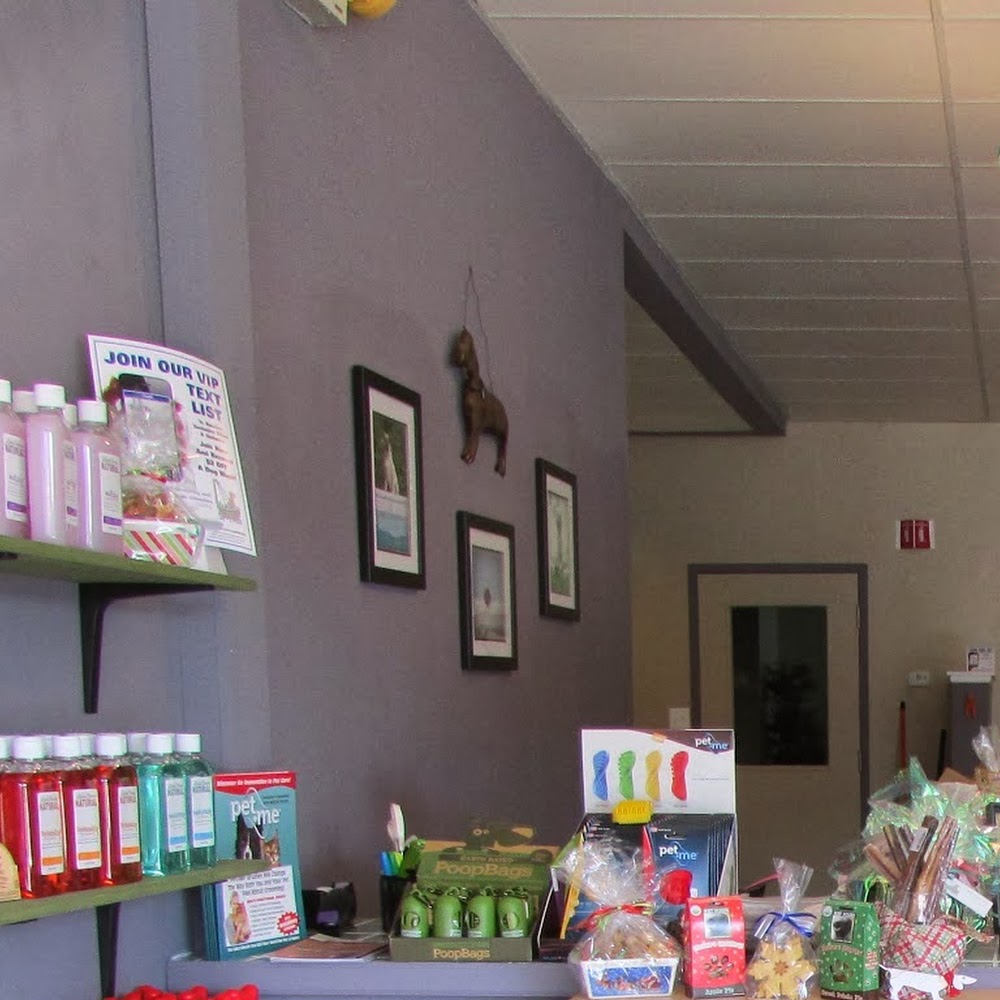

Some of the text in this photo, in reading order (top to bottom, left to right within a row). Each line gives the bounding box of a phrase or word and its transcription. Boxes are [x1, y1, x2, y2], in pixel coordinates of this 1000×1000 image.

[104, 352, 219, 389] JOIN OUR VIP
[186, 383, 221, 406] TEXT
[191, 401, 222, 421] LIST
[694, 736, 711, 747] pet
[231, 796, 256, 822] pet
[659, 844, 679, 857] pet
[433, 861, 534, 878] PoopBags
[433, 948, 491, 960] PoopBags
